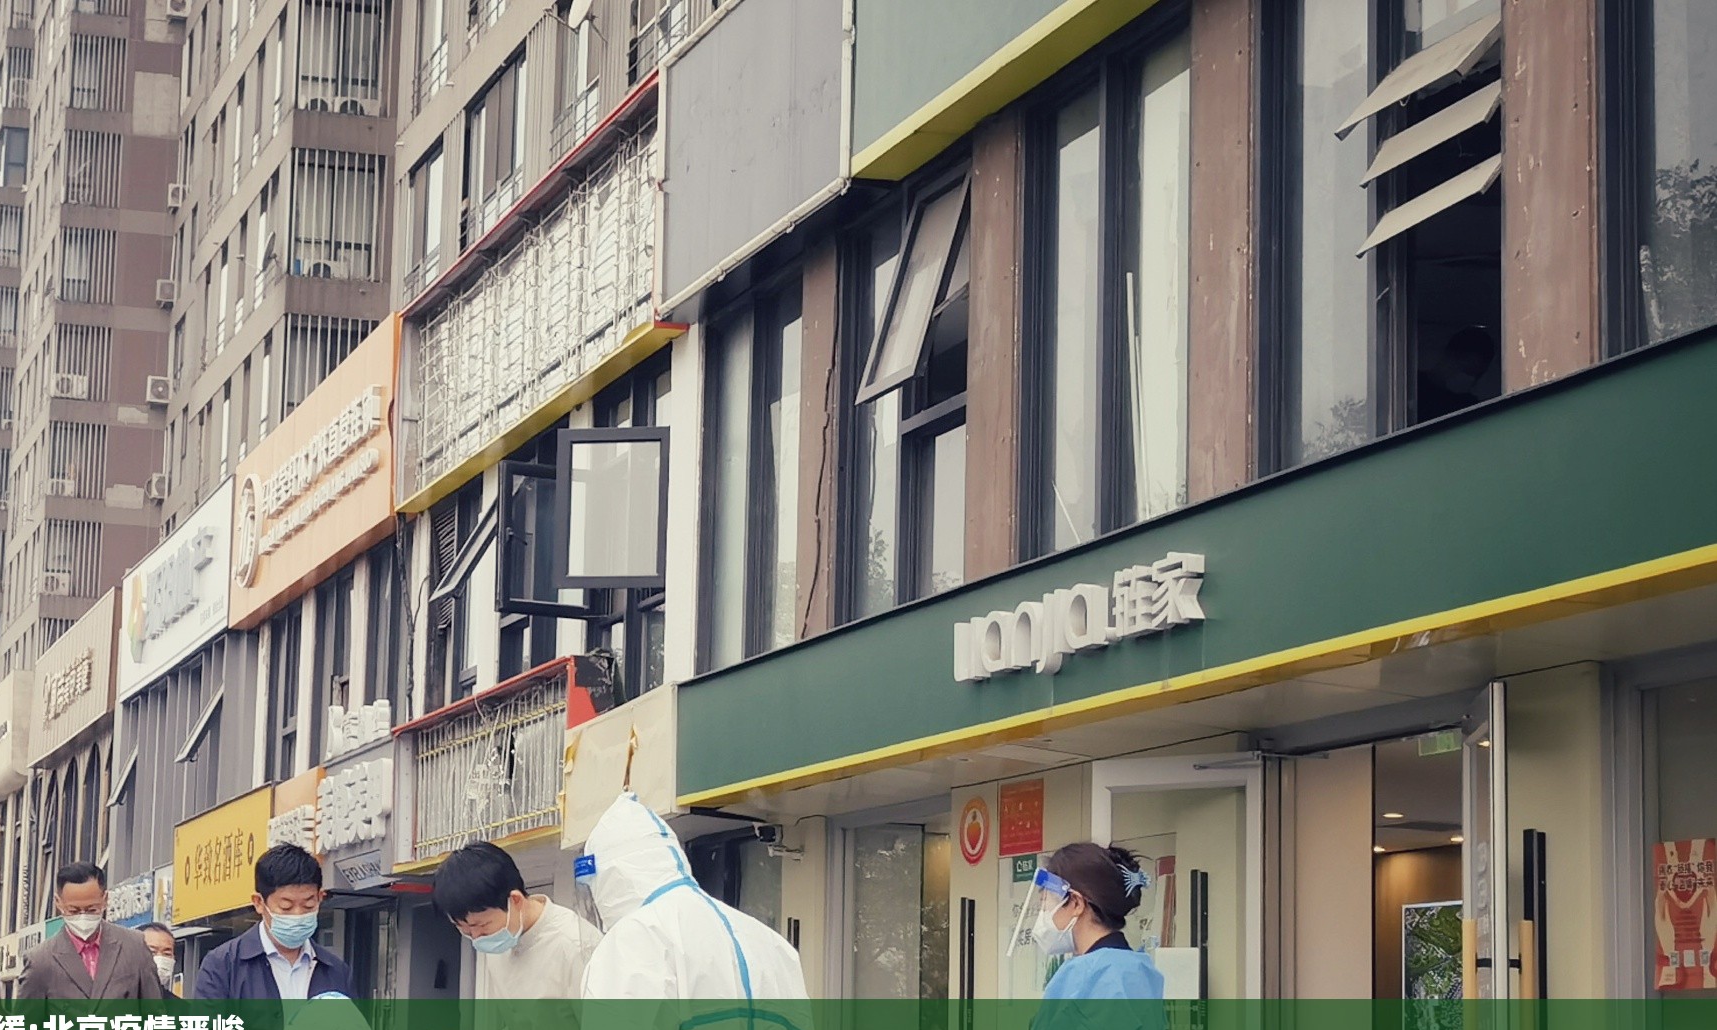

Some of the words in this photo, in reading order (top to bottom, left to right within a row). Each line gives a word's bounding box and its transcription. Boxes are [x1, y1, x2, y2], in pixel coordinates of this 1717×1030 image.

[1112, 552, 1205, 637] 链家
[194, 828, 244, 890] 华致名酒库
